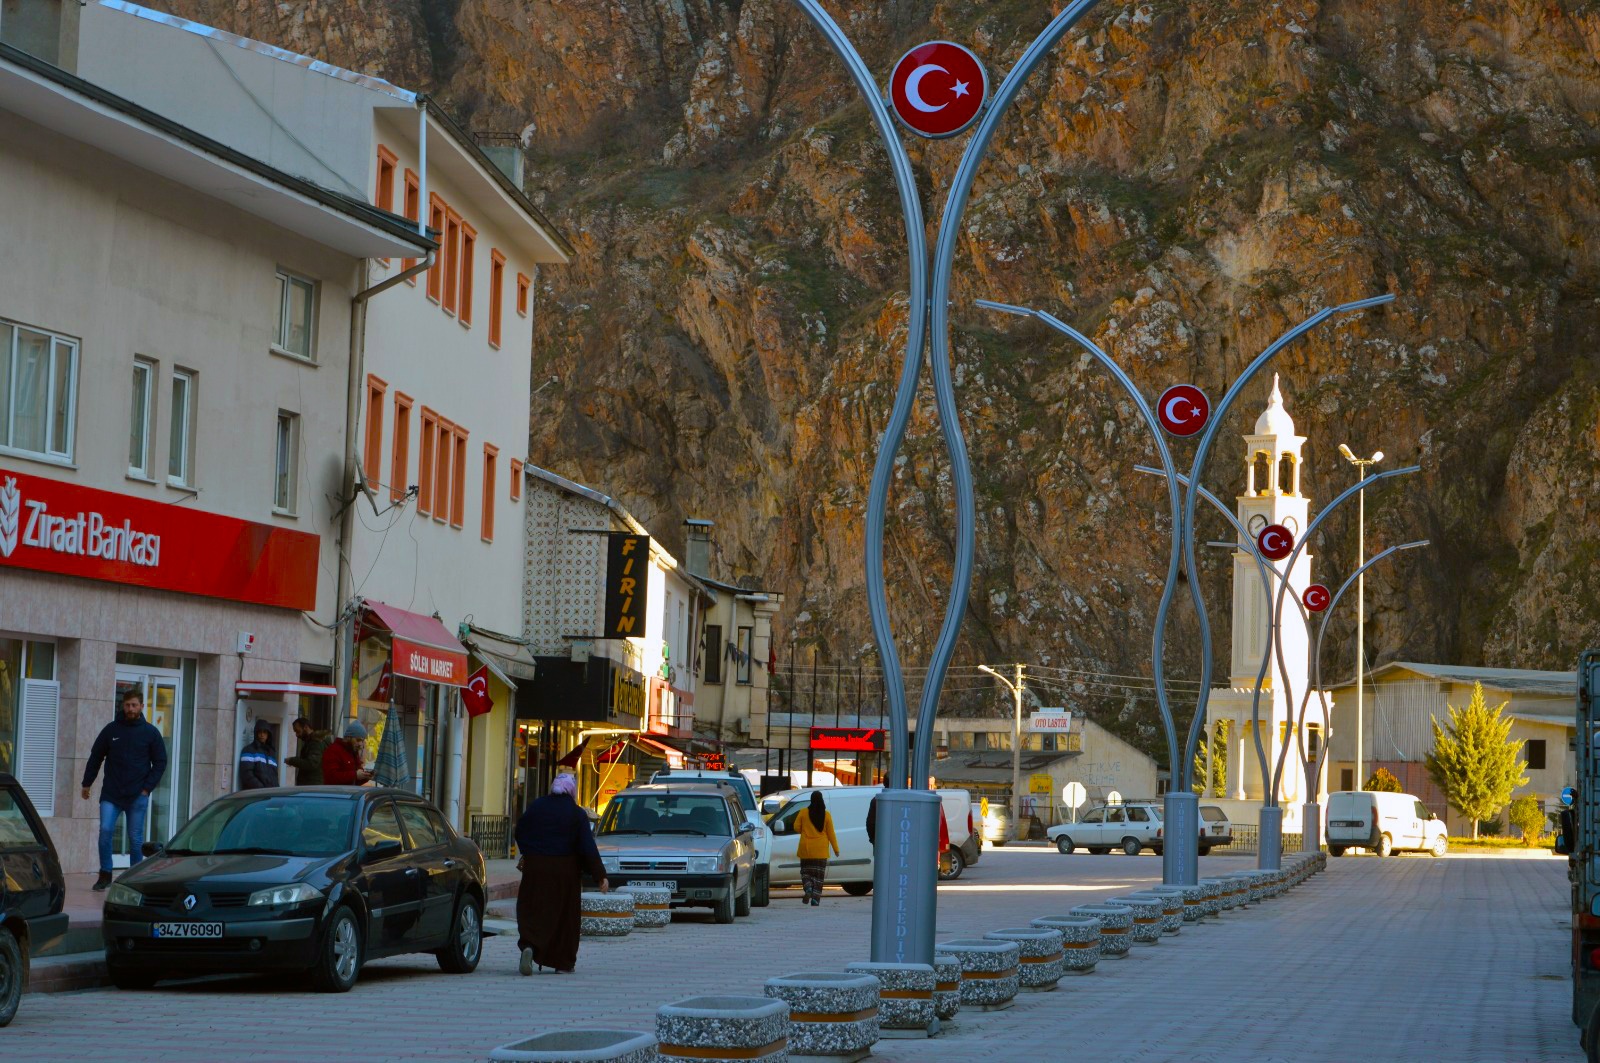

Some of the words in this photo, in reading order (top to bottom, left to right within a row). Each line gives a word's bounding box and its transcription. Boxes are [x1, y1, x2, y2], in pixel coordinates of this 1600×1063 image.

[22, 498, 86, 555] Ziraat
[87, 511, 160, 567] Bankası
[616, 538, 638, 633] FIRIN
[430, 657, 453, 679] MARKET
[1035, 718, 1047, 728] OTO
[900, 805, 911, 868] TORUL
[160, 923, 222, 937] 34ZV6090
